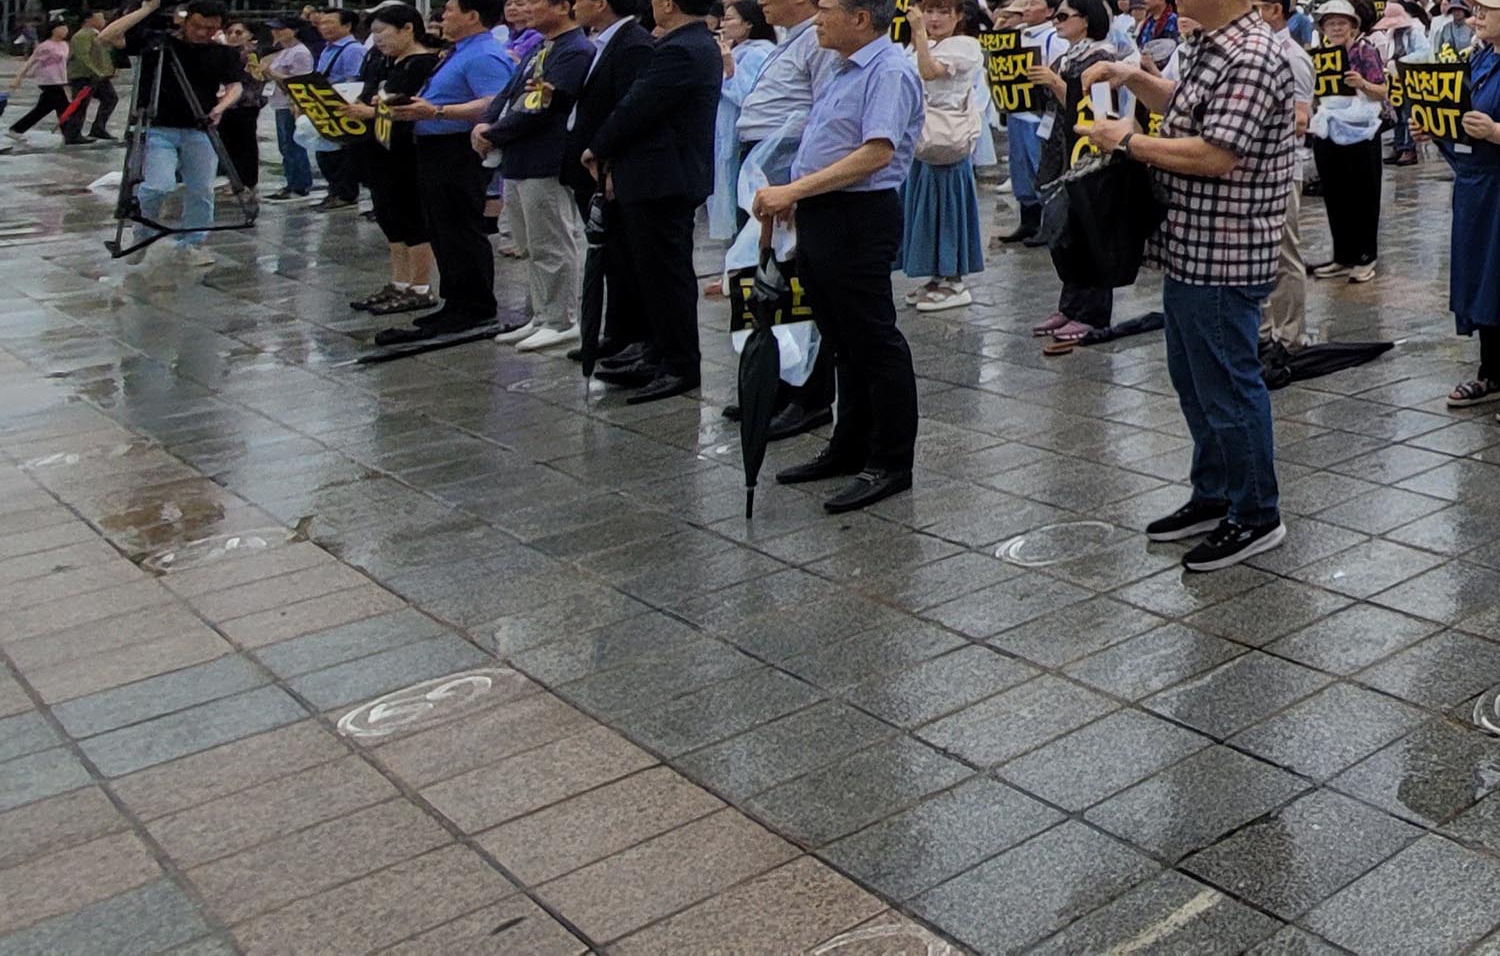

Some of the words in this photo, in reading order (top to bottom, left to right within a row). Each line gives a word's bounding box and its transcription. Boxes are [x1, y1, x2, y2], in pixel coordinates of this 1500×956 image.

[992, 83, 1034, 111] OUT
[1405, 70, 1464, 103] 신천지
[1411, 104, 1460, 139] OUT
